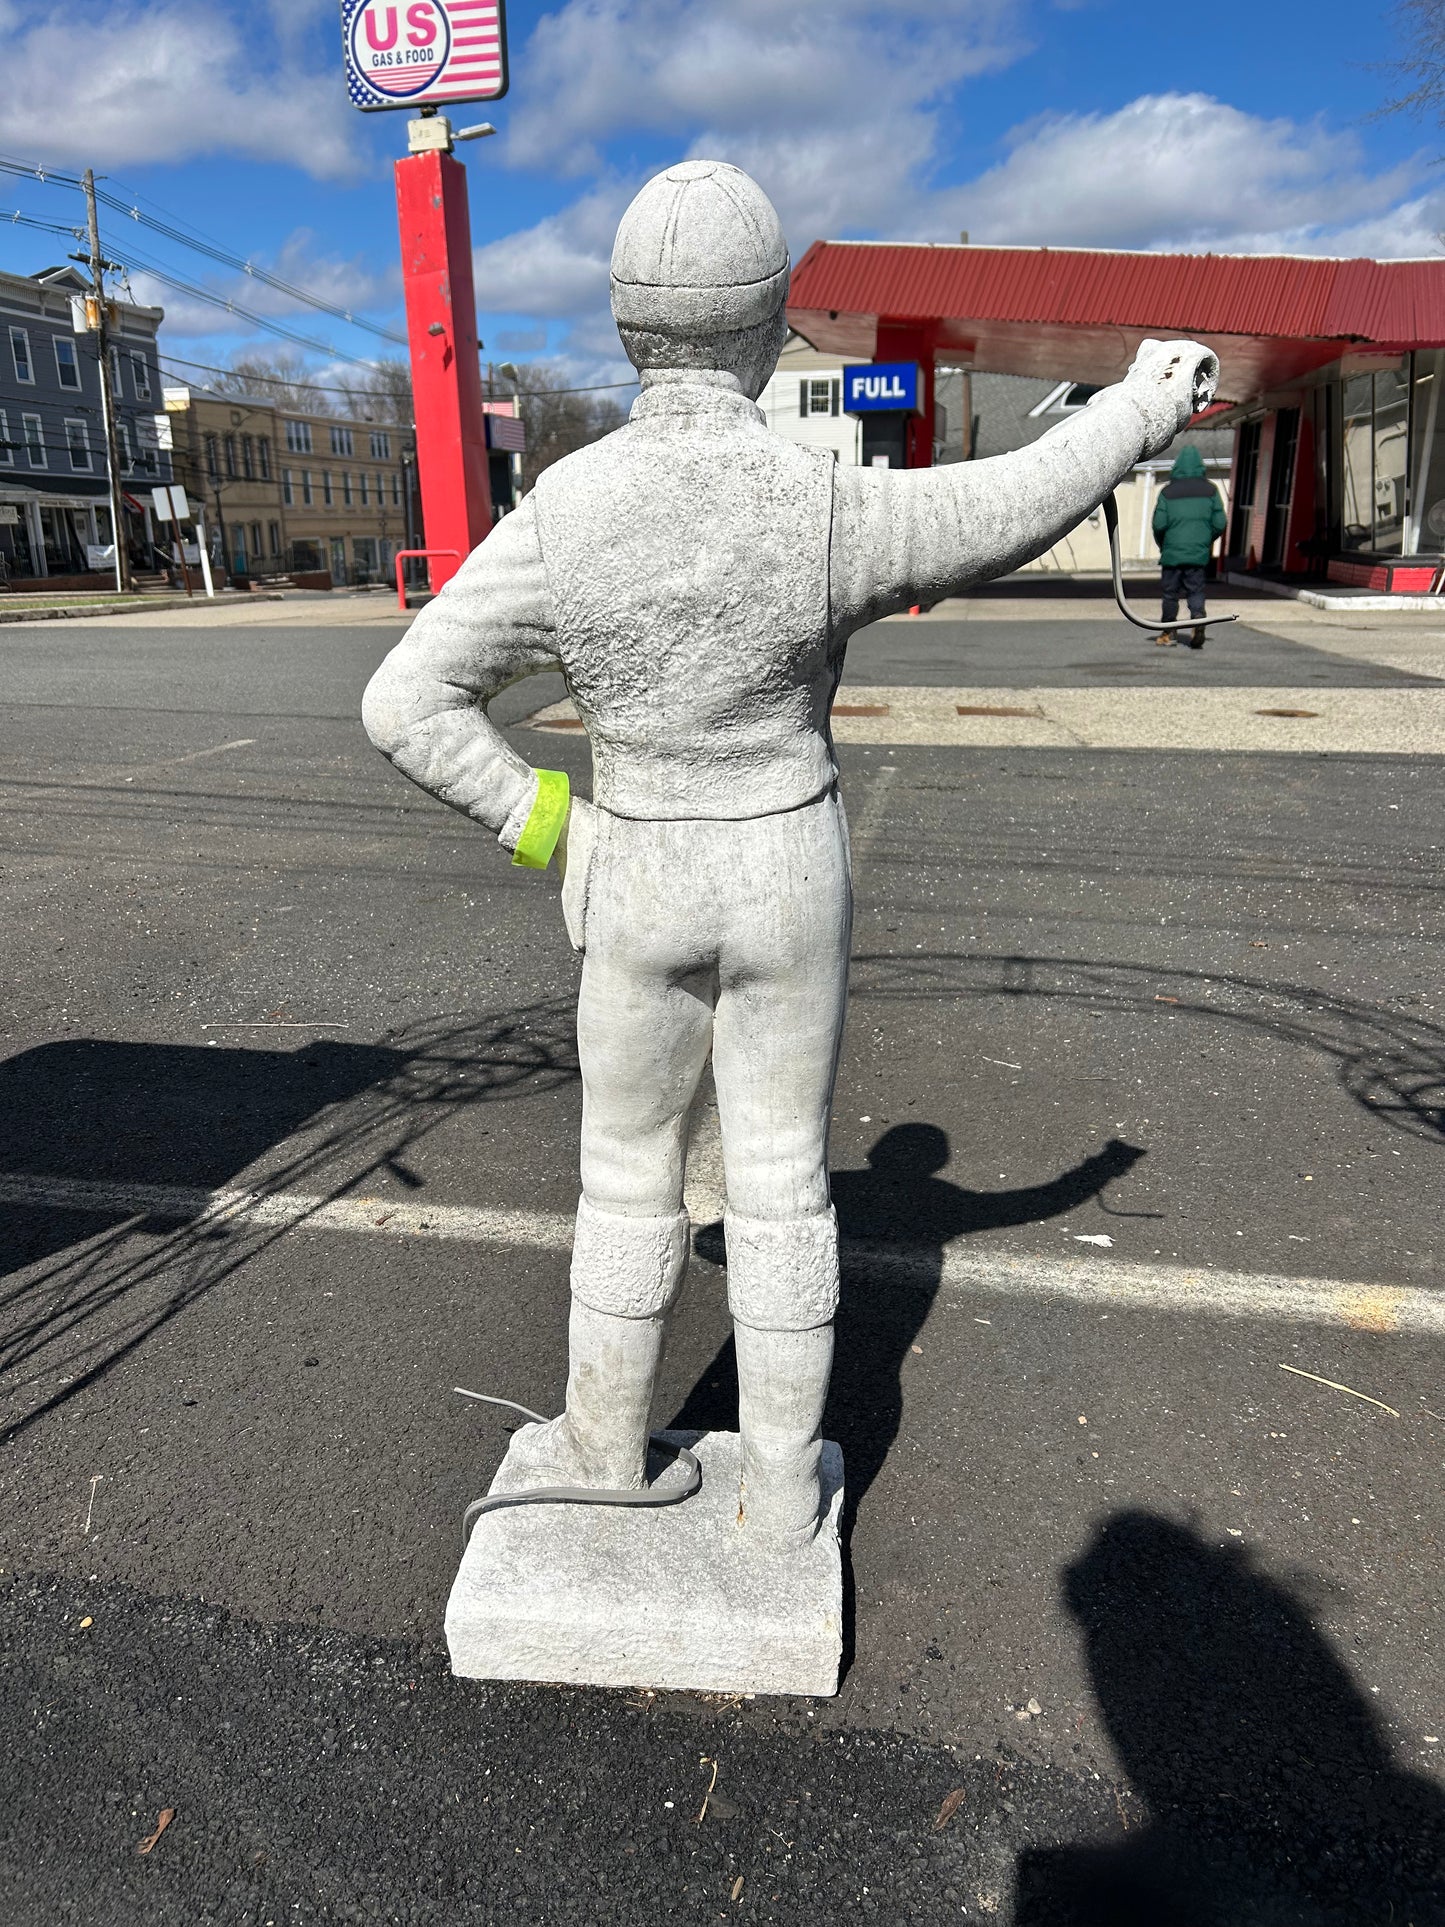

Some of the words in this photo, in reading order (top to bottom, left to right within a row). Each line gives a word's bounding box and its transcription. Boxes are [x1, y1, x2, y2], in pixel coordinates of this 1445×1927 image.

[364, 2, 437, 51] US
[372, 52, 393, 67] GAS
[395, 51, 403, 64] &
[406, 48, 434, 63] FOOD
[852, 375, 906, 399] FULL
